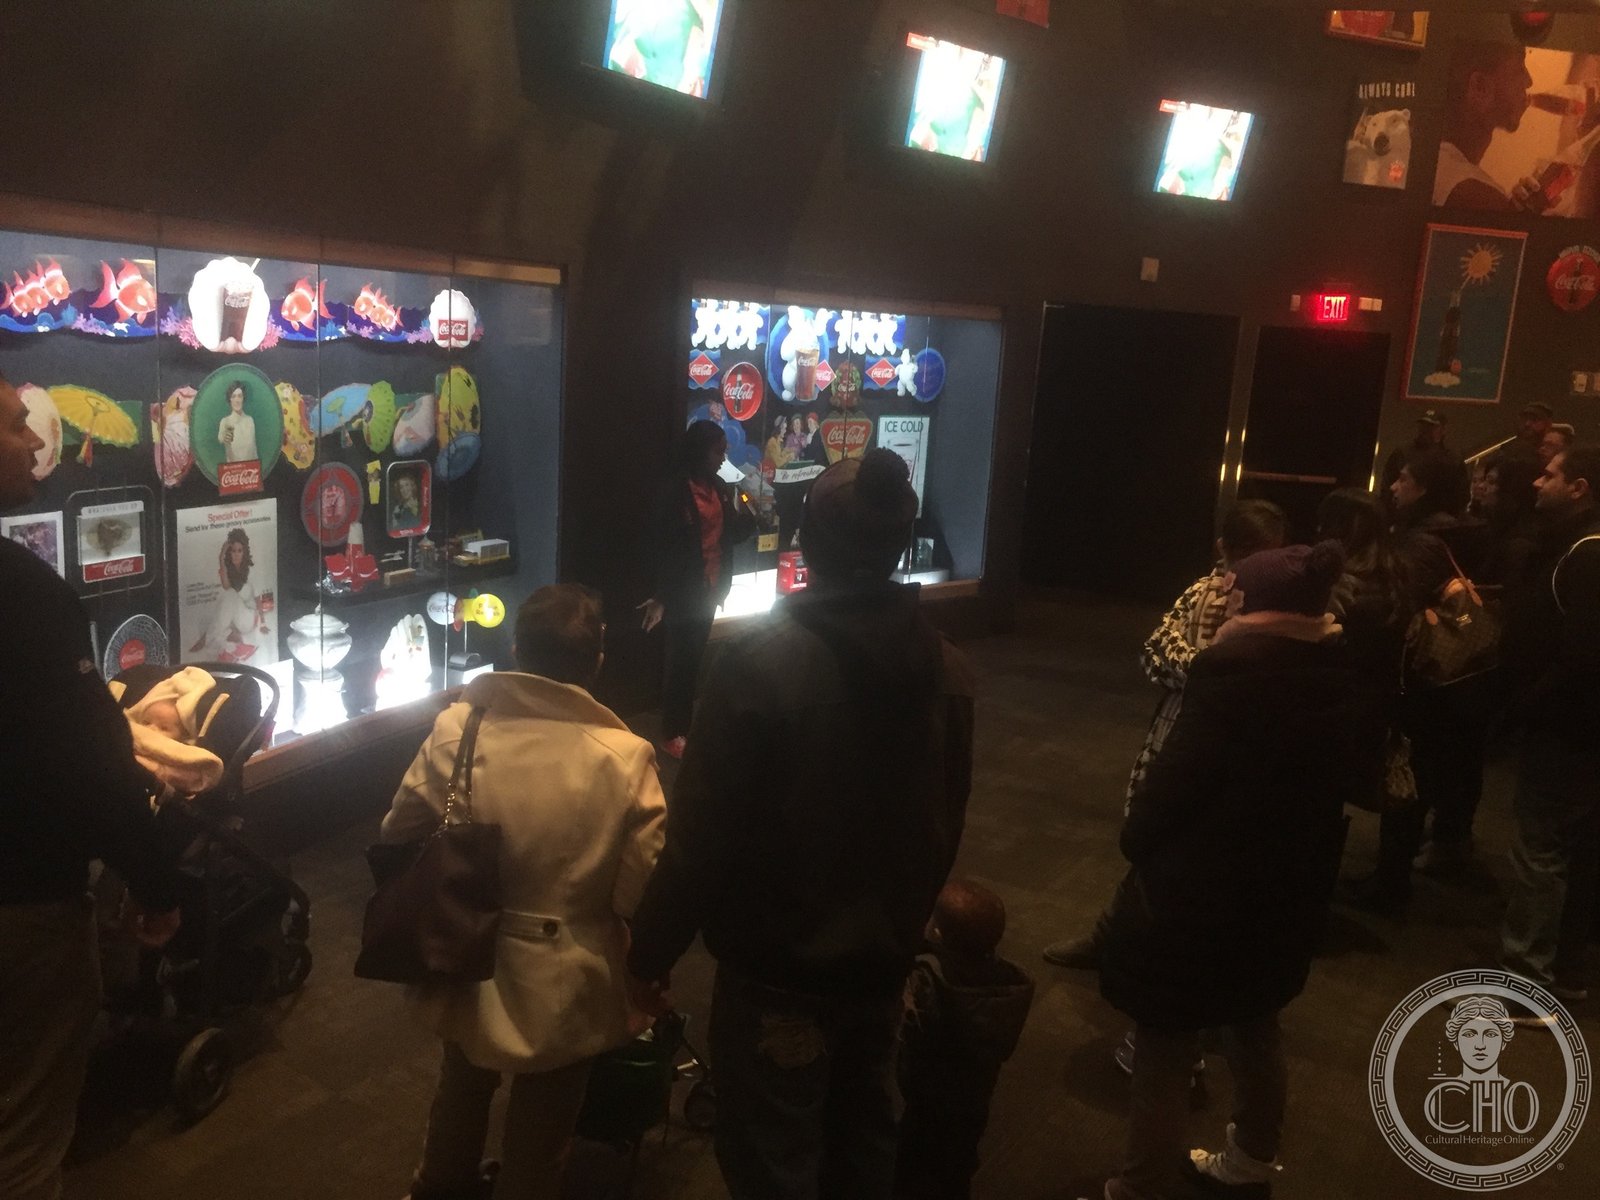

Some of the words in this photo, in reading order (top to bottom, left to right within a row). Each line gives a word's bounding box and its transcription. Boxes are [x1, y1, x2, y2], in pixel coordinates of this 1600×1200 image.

[1323, 296, 1346, 319] EXIT
[827, 425, 866, 445] CocaCola
[884, 421, 899, 433] ICE
[900, 421, 924, 433] COLD
[207, 511, 233, 523] Special
